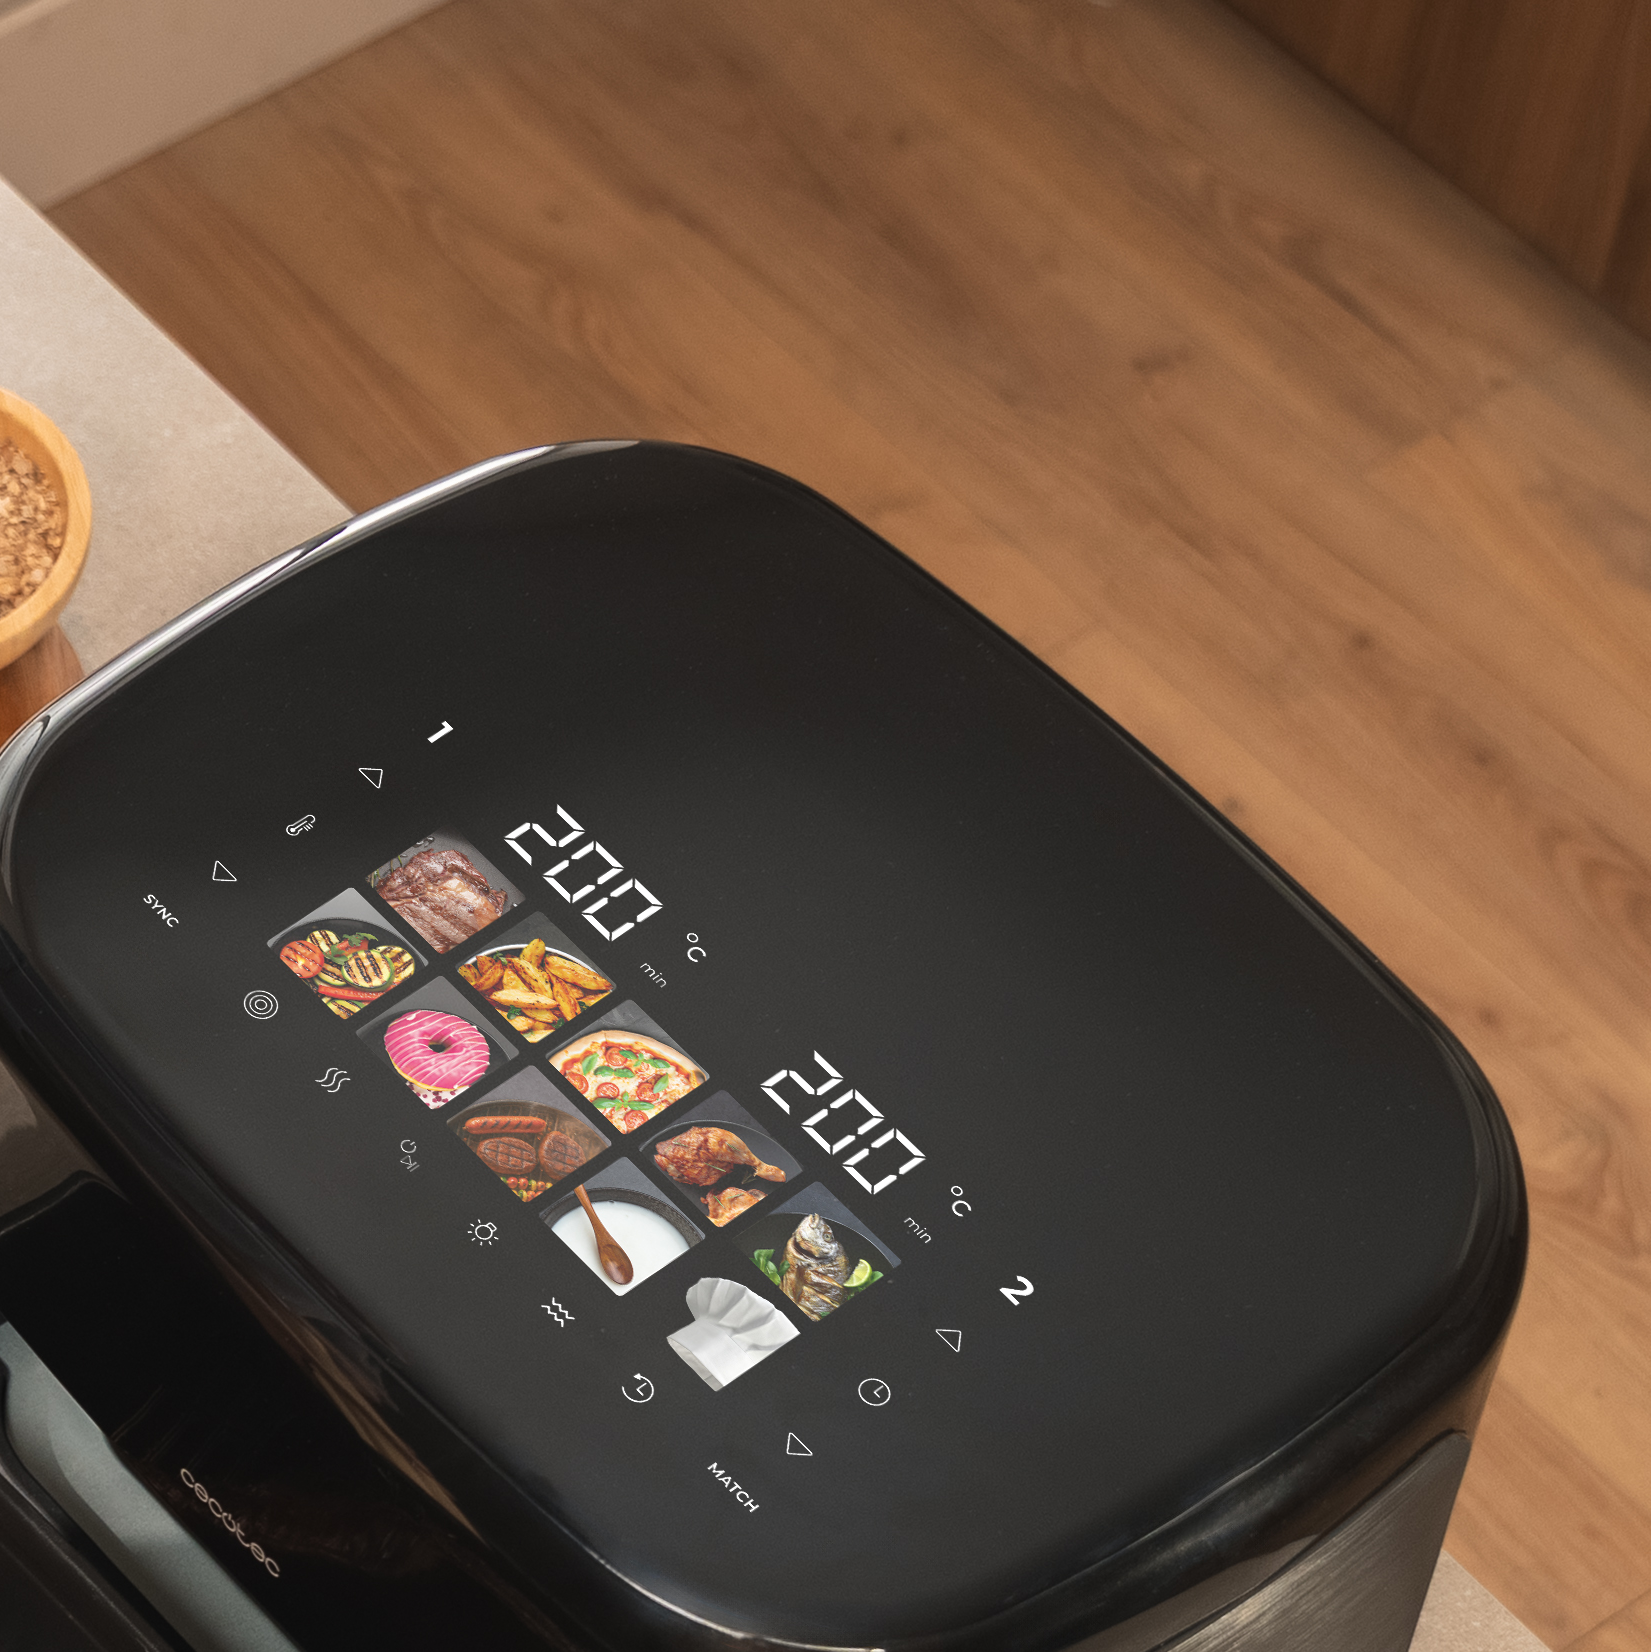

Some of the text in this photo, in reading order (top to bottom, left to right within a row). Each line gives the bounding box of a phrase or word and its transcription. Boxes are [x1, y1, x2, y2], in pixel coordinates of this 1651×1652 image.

[427, 720, 454, 744] 1
[504, 804, 664, 942] 200
[142, 894, 180, 928] SYNC
[639, 962, 667, 989] min
[760, 1050, 926, 1195] 200
[903, 1216, 933, 1244] min
[999, 1275, 1035, 1306] 2
[707, 1462, 760, 1513] MATCH
[180, 1468, 280, 1577] cecotec
